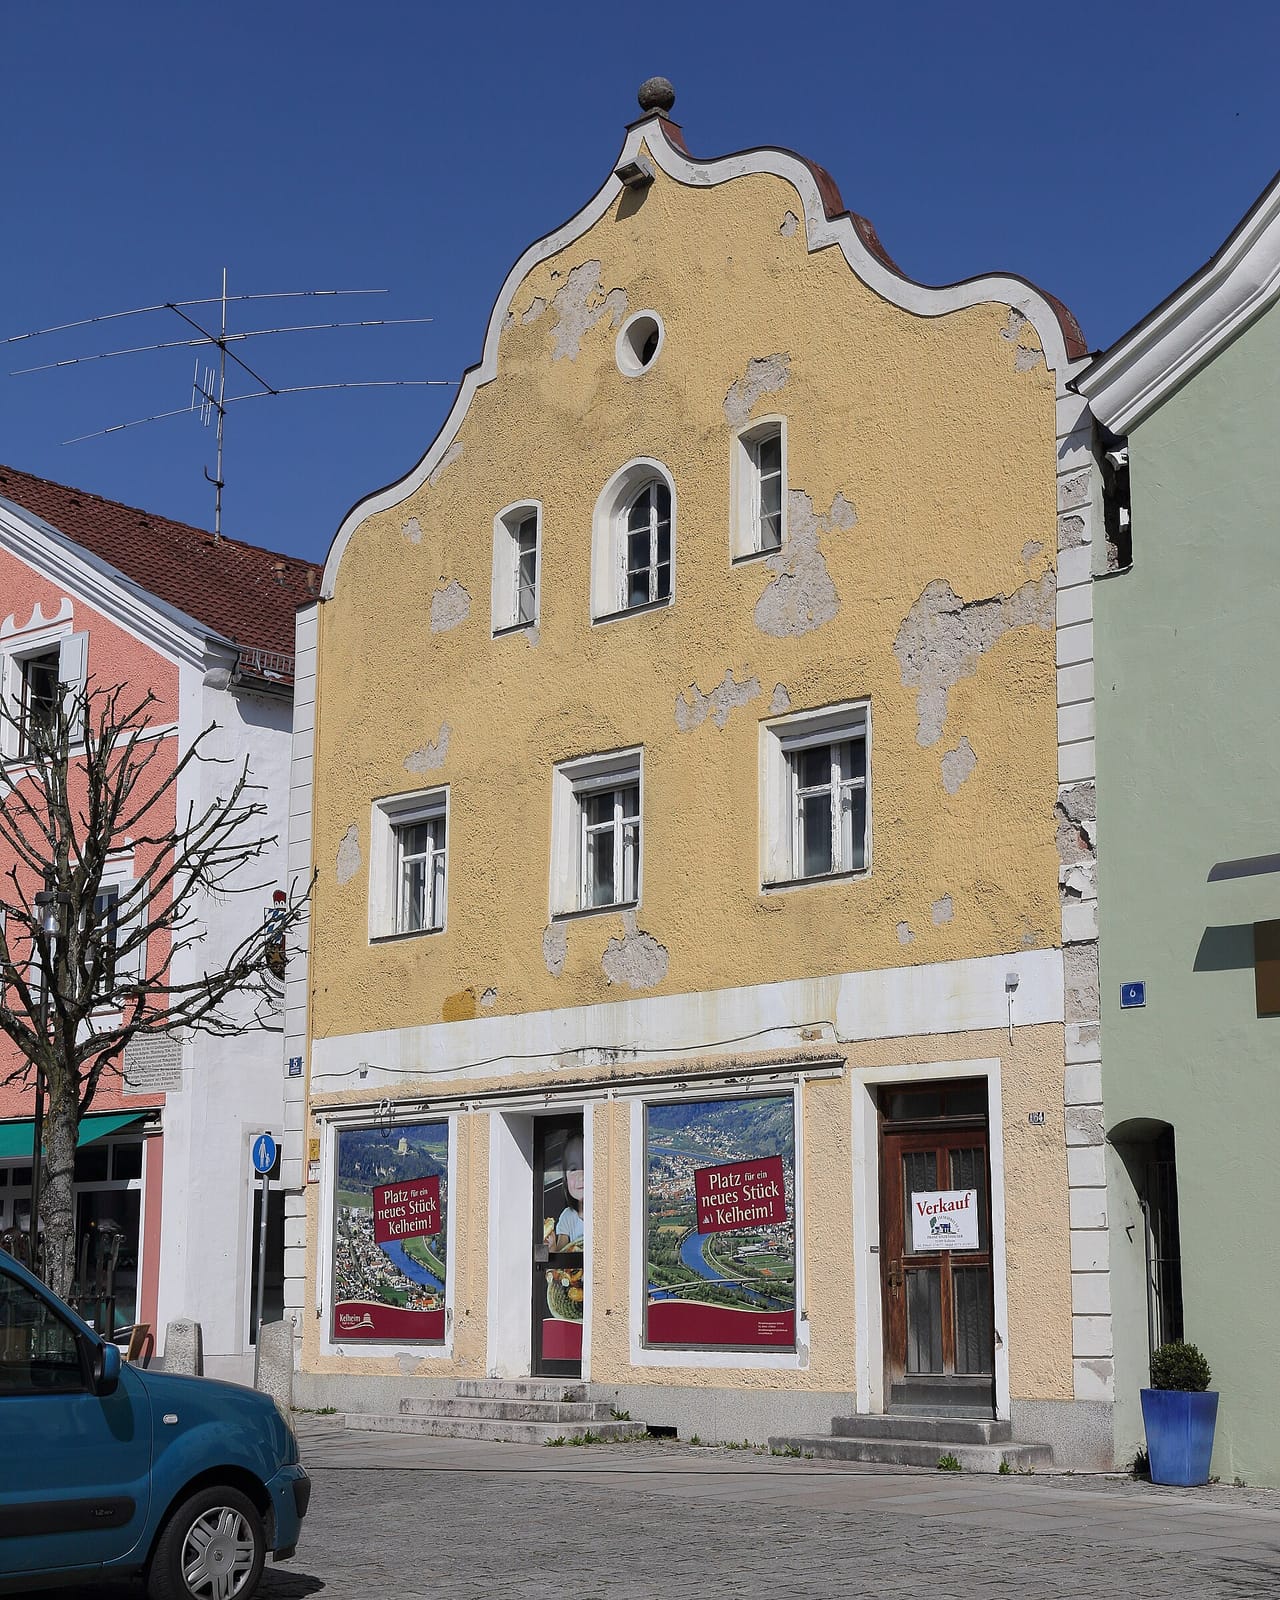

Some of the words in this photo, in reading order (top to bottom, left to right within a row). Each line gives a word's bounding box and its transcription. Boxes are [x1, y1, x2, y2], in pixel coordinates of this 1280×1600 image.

[1129, 985, 1136, 998] 6
[708, 1173, 742, 1190] Platz
[744, 1172, 755, 1182] für
[756, 1170, 768, 1179] ein
[383, 1190, 409, 1205] Platz
[410, 1189, 419, 1198] für
[419, 1188, 428, 1196] ein
[701, 1191, 739, 1207] neues
[742, 1181, 780, 1201] Stück
[916, 1192, 971, 1216] Verkauf
[377, 1206, 406, 1220] neues
[408, 1197, 437, 1215] Stück
[716, 1201, 774, 1225] Kelheim!
[388, 1215, 432, 1235] Kelheim!
[339, 1313, 361, 1322] Kelheim
